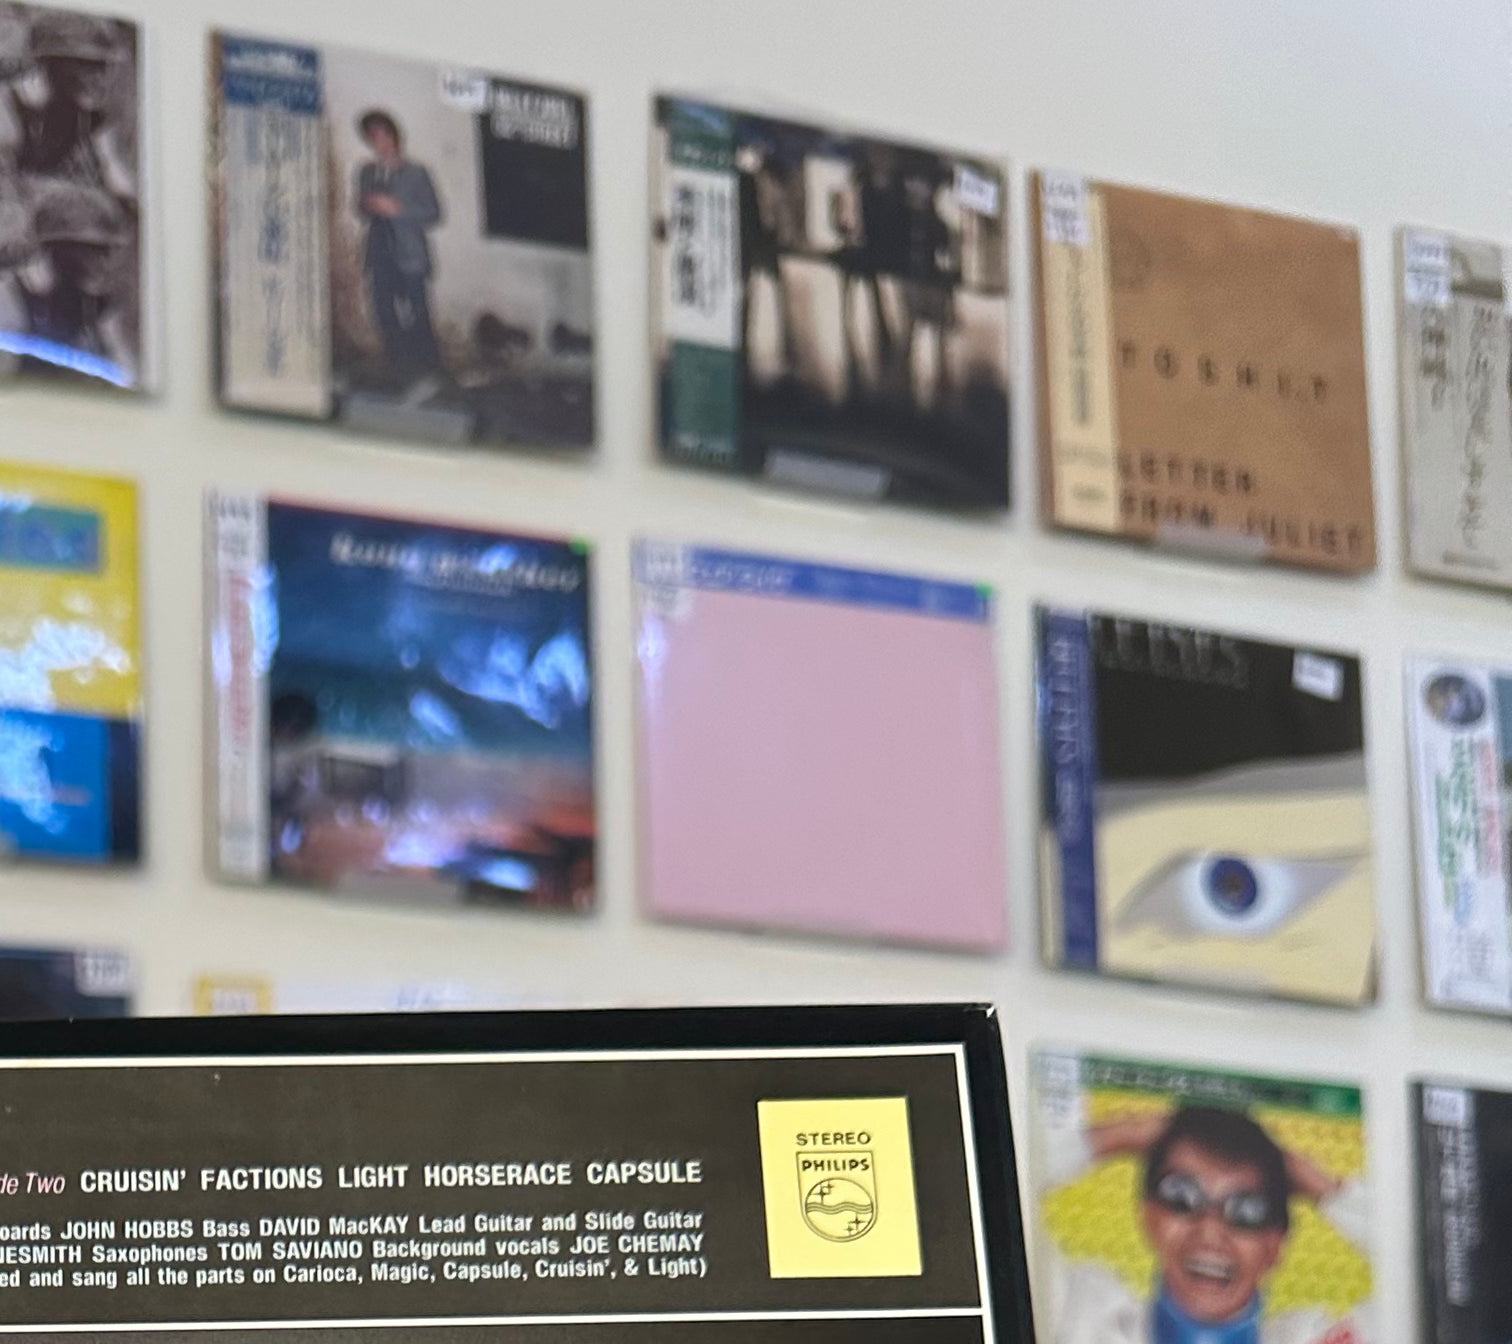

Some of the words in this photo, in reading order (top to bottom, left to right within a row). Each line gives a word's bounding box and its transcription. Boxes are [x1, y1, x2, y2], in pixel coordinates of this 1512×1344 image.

[795, 1131, 872, 1147] STEREO
[25, 1171, 66, 1194] Two
[200, 1166, 323, 1191] FACTIONS
[338, 1165, 409, 1188] LIGHT
[424, 1163, 572, 1187] HORSERACE
[586, 1161, 702, 1184] CAPSULE
[801, 1158, 870, 1172] PHILIPS
[60, 1221, 116, 1240] JOHN
[124, 1220, 194, 1239] HOBBS
[202, 1219, 251, 1238] Bass
[259, 1218, 321, 1237] DAVID
[328, 1216, 409, 1236] MacKAY
[418, 1215, 466, 1234] Lead
[474, 1213, 533, 1233] Guitar
[541, 1212, 577, 1231] and
[584, 1211, 635, 1230] Slide
[643, 1209, 703, 1228] Guitar
[29, 1268, 63, 1287] and
[72, 1272, 118, 1289] sang
[126, 1267, 150, 1286] all
[157, 1267, 189, 1285] the
[195, 1266, 245, 1288] parts
[252, 1269, 276, 1284] on
[283, 1264, 363, 1285] Carioca,
[370, 1262, 436, 1285] Magic,
[443, 1260, 528, 1283] Capsule,
[623, 1257, 639, 1276] &
[647, 1255, 707, 1278] Light)
